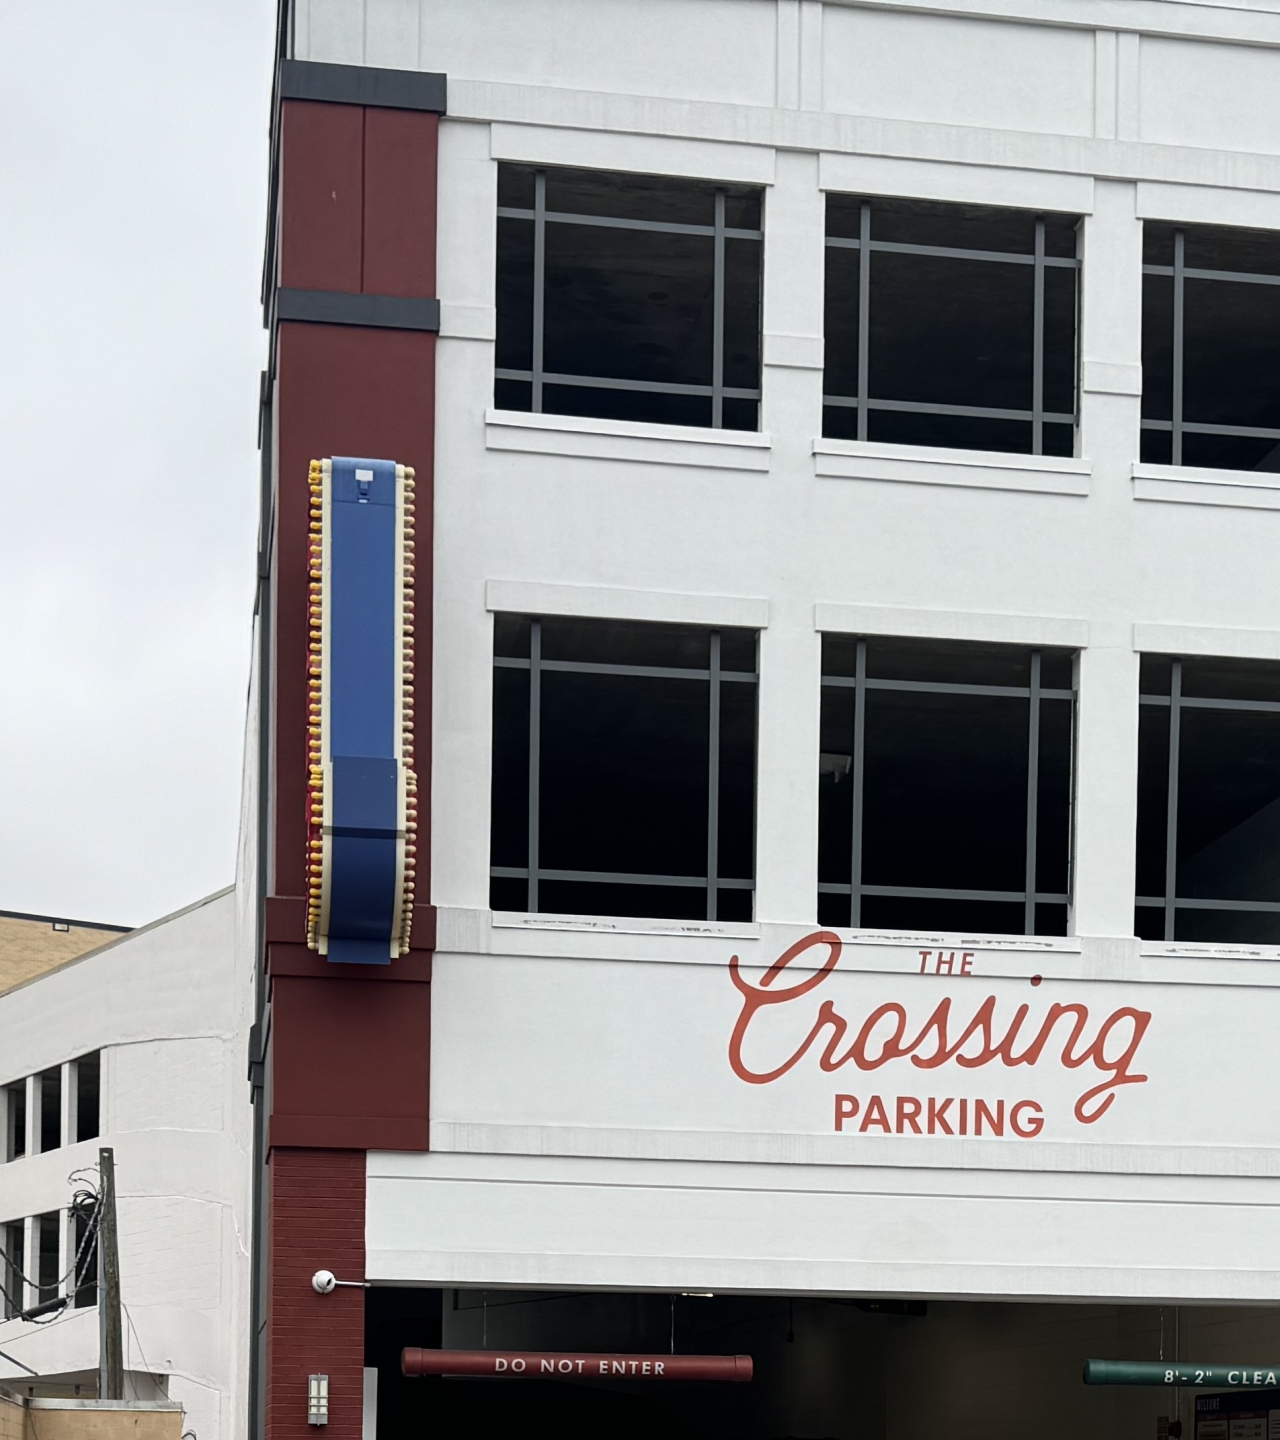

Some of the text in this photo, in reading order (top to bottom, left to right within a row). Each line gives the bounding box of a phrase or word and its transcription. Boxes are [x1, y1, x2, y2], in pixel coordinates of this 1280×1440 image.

[918, 951, 974, 976] THE
[729, 931, 1151, 1124] Crossing
[834, 1094, 1045, 1138] PARKING
[494, 1357, 666, 1375] DO NOT ENTER
